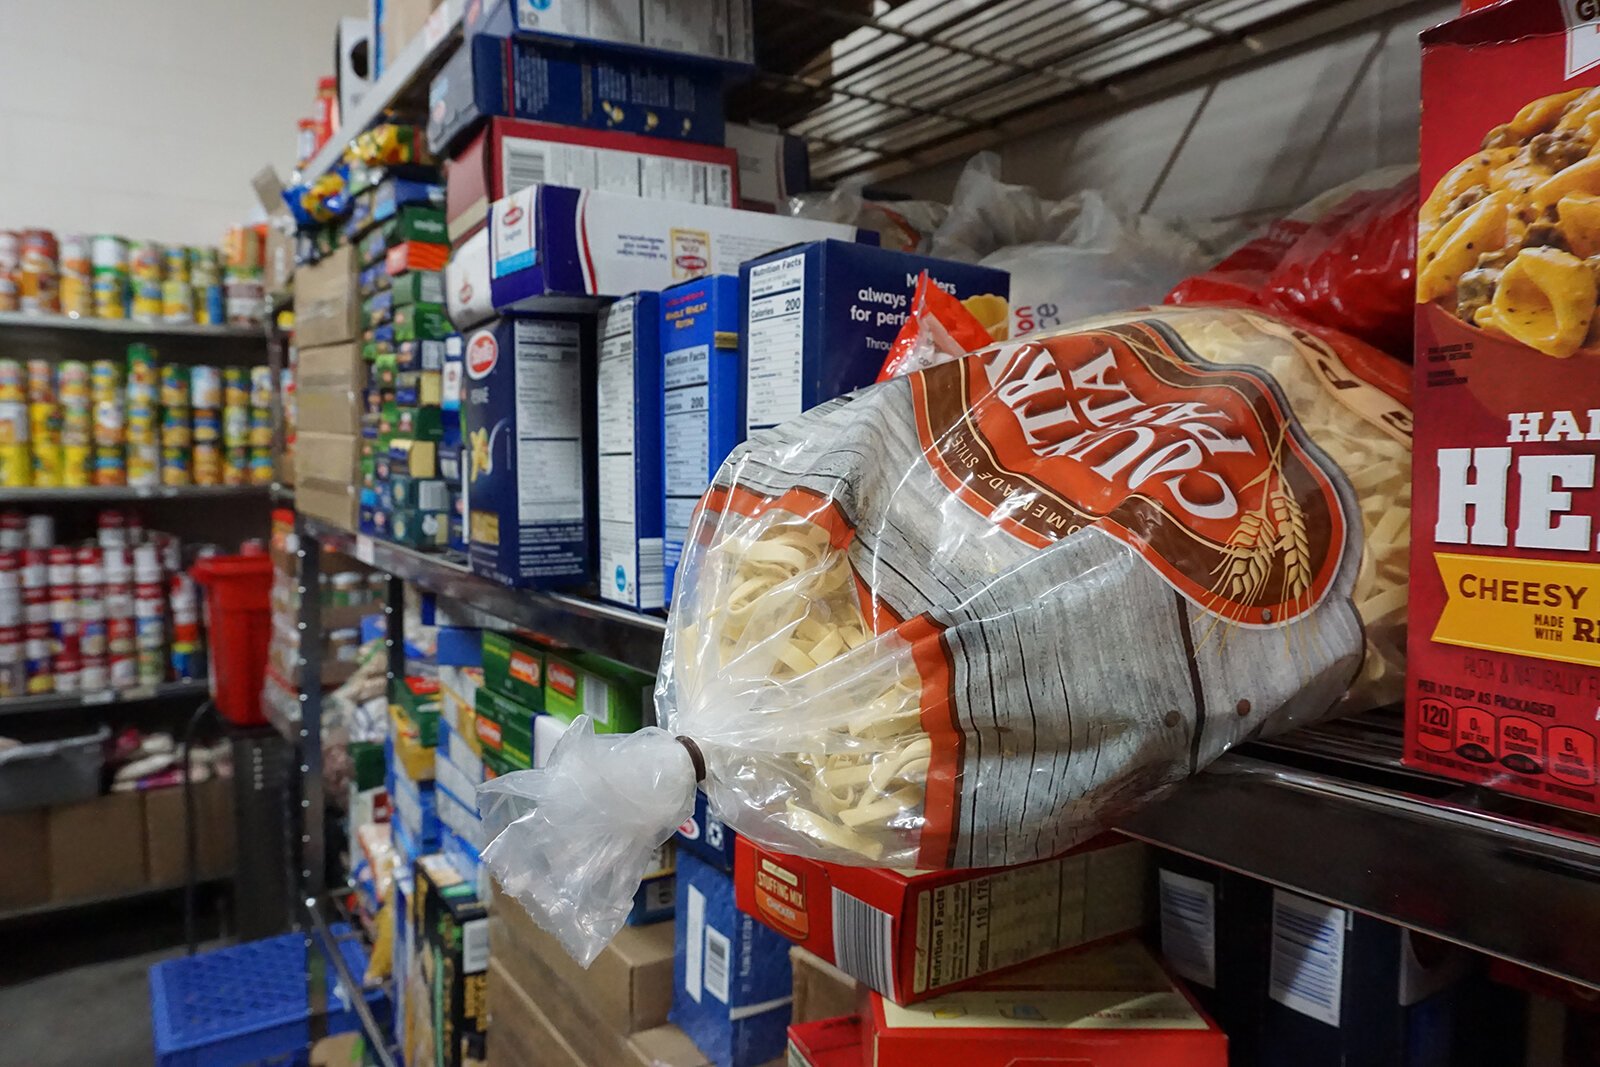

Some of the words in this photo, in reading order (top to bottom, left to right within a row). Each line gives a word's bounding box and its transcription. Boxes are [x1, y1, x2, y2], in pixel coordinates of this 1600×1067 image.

[1576, 0, 1600, 21] G
[753, 264, 780, 276] Nutrition
[782, 258, 802, 269] Facts
[752, 308, 774, 319] Calories
[785, 297, 801, 312] 200
[858, 287, 907, 309] always
[850, 305, 871, 322] for
[1069, 346, 1257, 457] PASTA
[975, 342, 1239, 520] COUNTRY
[951, 435, 980, 469] STYLE
[1434, 446, 1600, 552] HE
[1458, 573, 1589, 611] CHEESY
[1534, 613, 1564, 629] MADE
[1534, 627, 1563, 643] WITH
[1573, 616, 1600, 644] R
[1464, 656, 1495, 680] PASTA
[1418, 679, 1436, 694] PER
[1454, 686, 1475, 701] CUP
[1477, 691, 1491, 706] AS
[1494, 694, 1556, 718] PACKAGED
[1422, 703, 1449, 728] 120
[1476, 734, 1490, 745] FAT
[934, 889, 945, 927] Facts
[976, 906, 988, 928] 110
[931, 929, 945, 987] Nutrition
